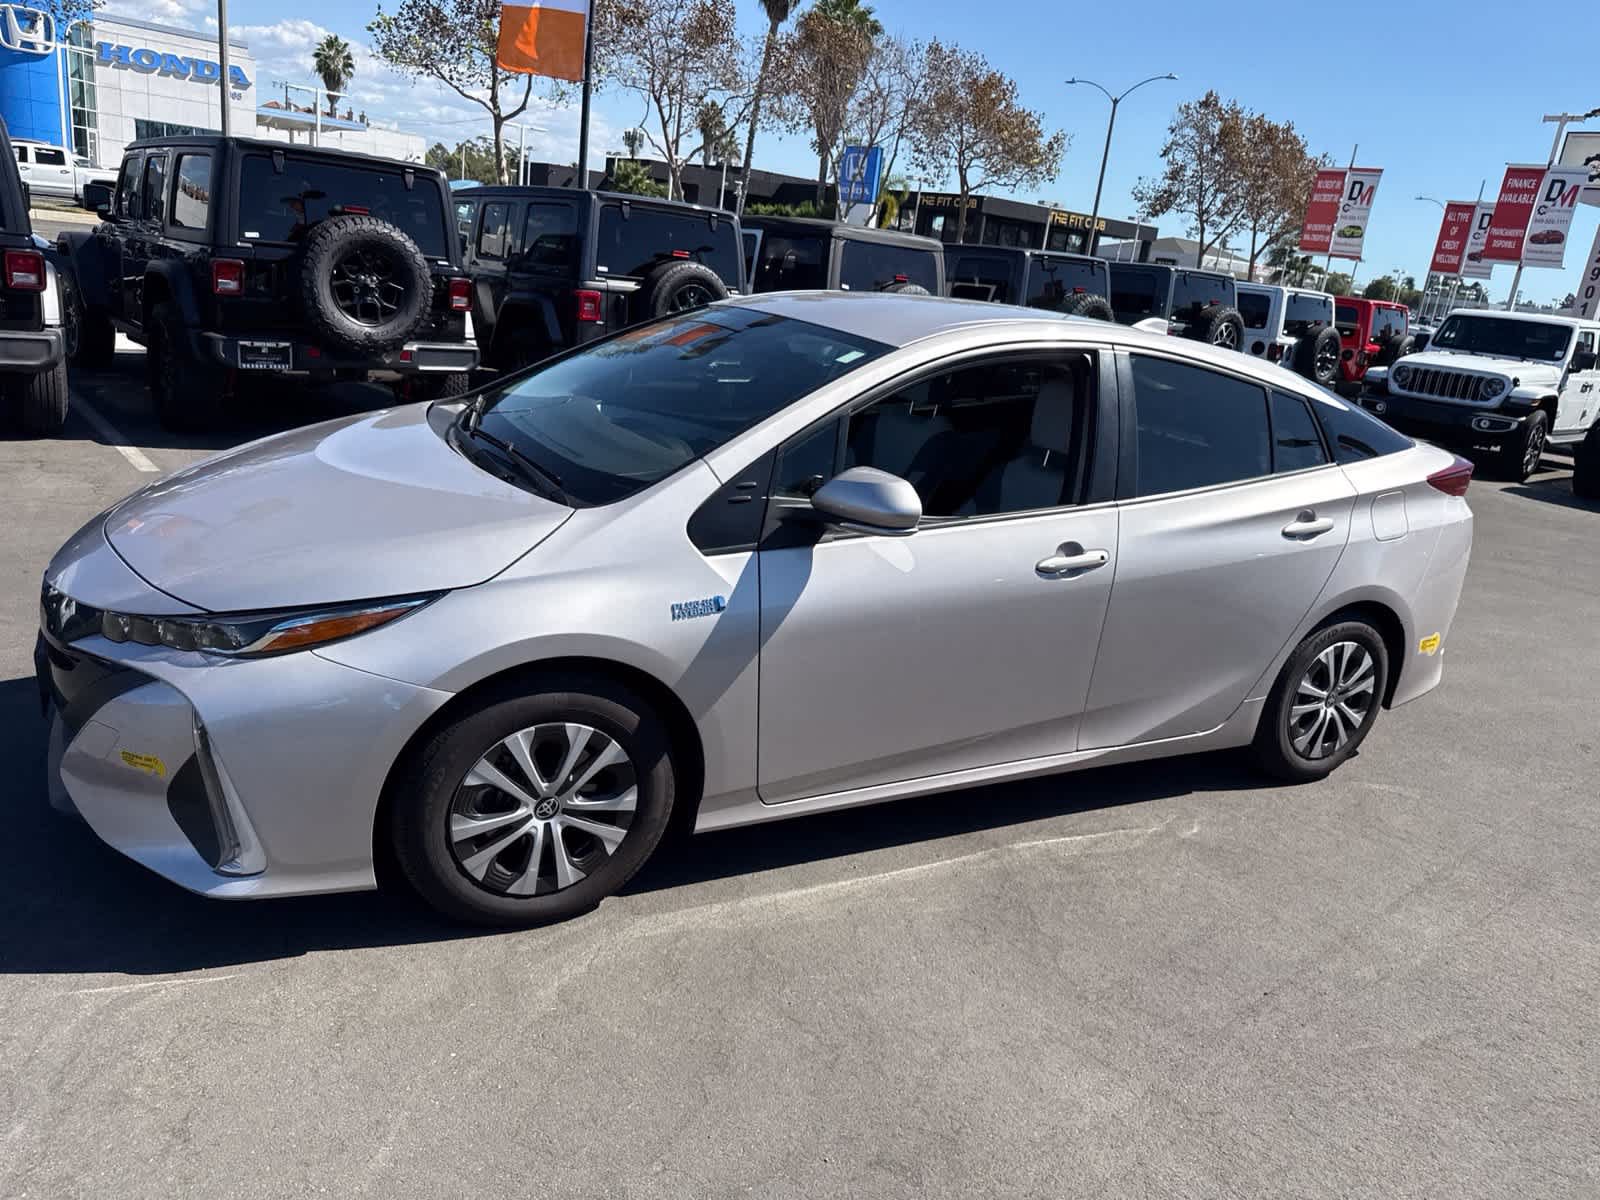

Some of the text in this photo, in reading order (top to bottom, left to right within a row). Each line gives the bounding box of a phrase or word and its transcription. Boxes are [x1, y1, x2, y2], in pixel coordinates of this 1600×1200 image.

[96, 41, 252, 88] HONDA
[1506, 178, 1537, 189] FINANCE
[1499, 193, 1535, 204] AVAILABLE
[1084, 217, 1106, 231] CUB
